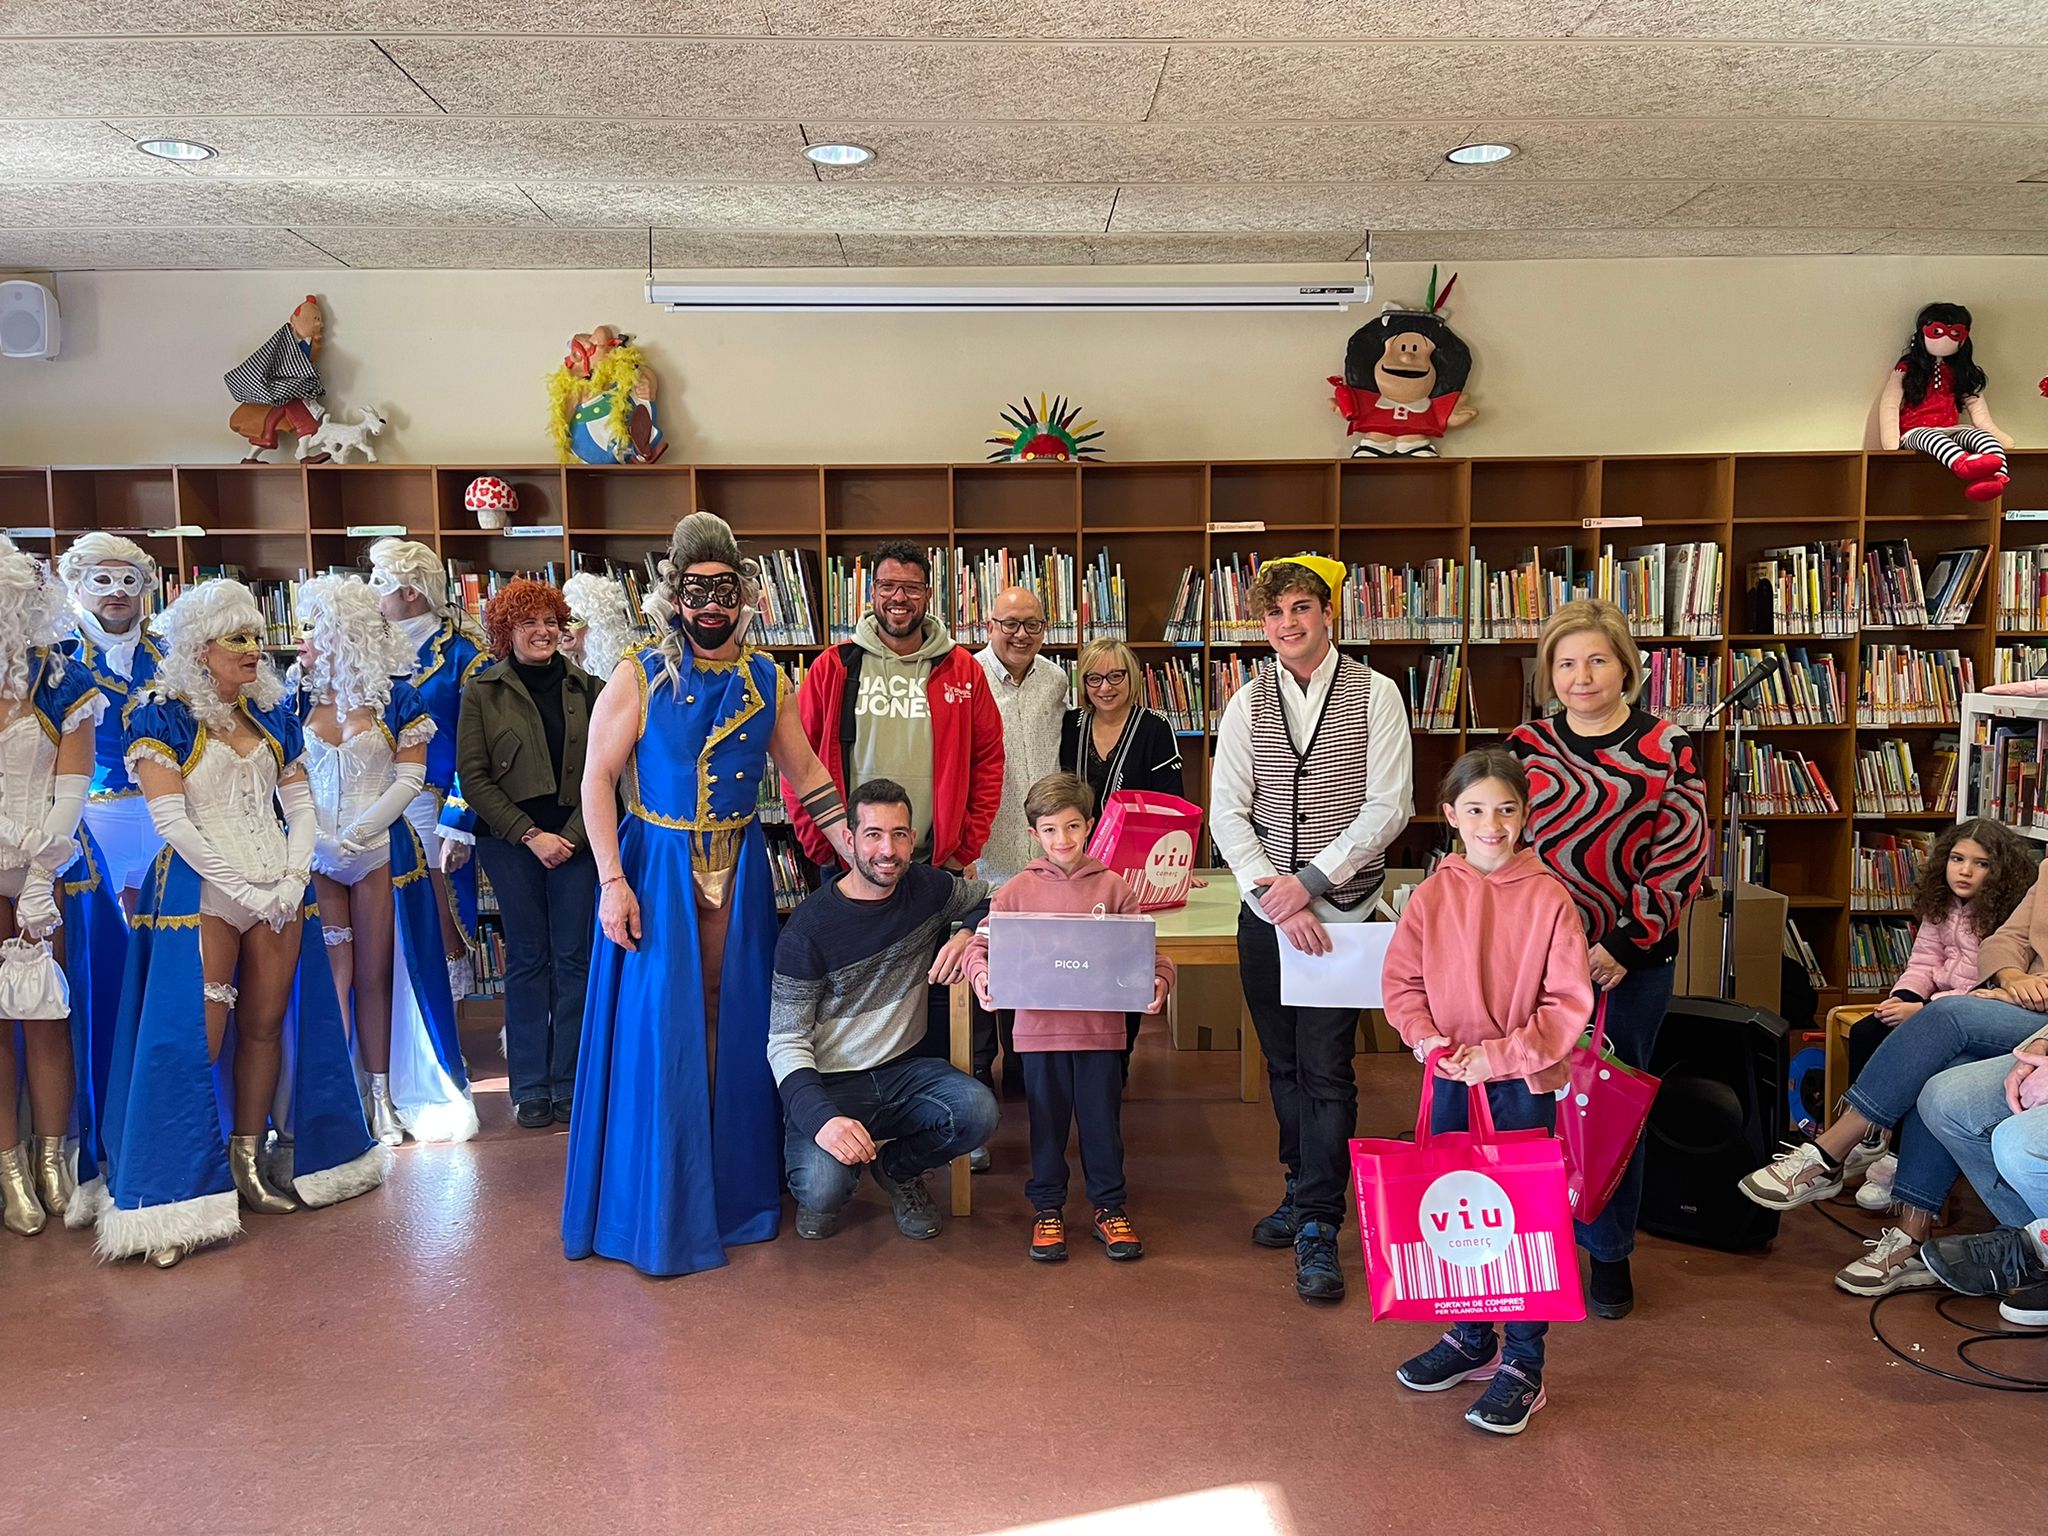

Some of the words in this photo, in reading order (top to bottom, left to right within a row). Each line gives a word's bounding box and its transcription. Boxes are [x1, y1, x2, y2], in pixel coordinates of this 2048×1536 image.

[858, 674, 926, 698] JACK
[1154, 847, 1188, 867] viu
[1055, 960, 1080, 969] PICO
[1082, 960, 1089, 969] 4
[1430, 1198, 1503, 1232] viu
[1448, 1237, 1492, 1248] comerç
[1434, 1301, 1471, 1309] PORTA'M
[1472, 1299, 1484, 1307] DE
[1485, 1297, 1525, 1307] COMPRES
[1499, 1304, 1525, 1312] GELTRÚ
